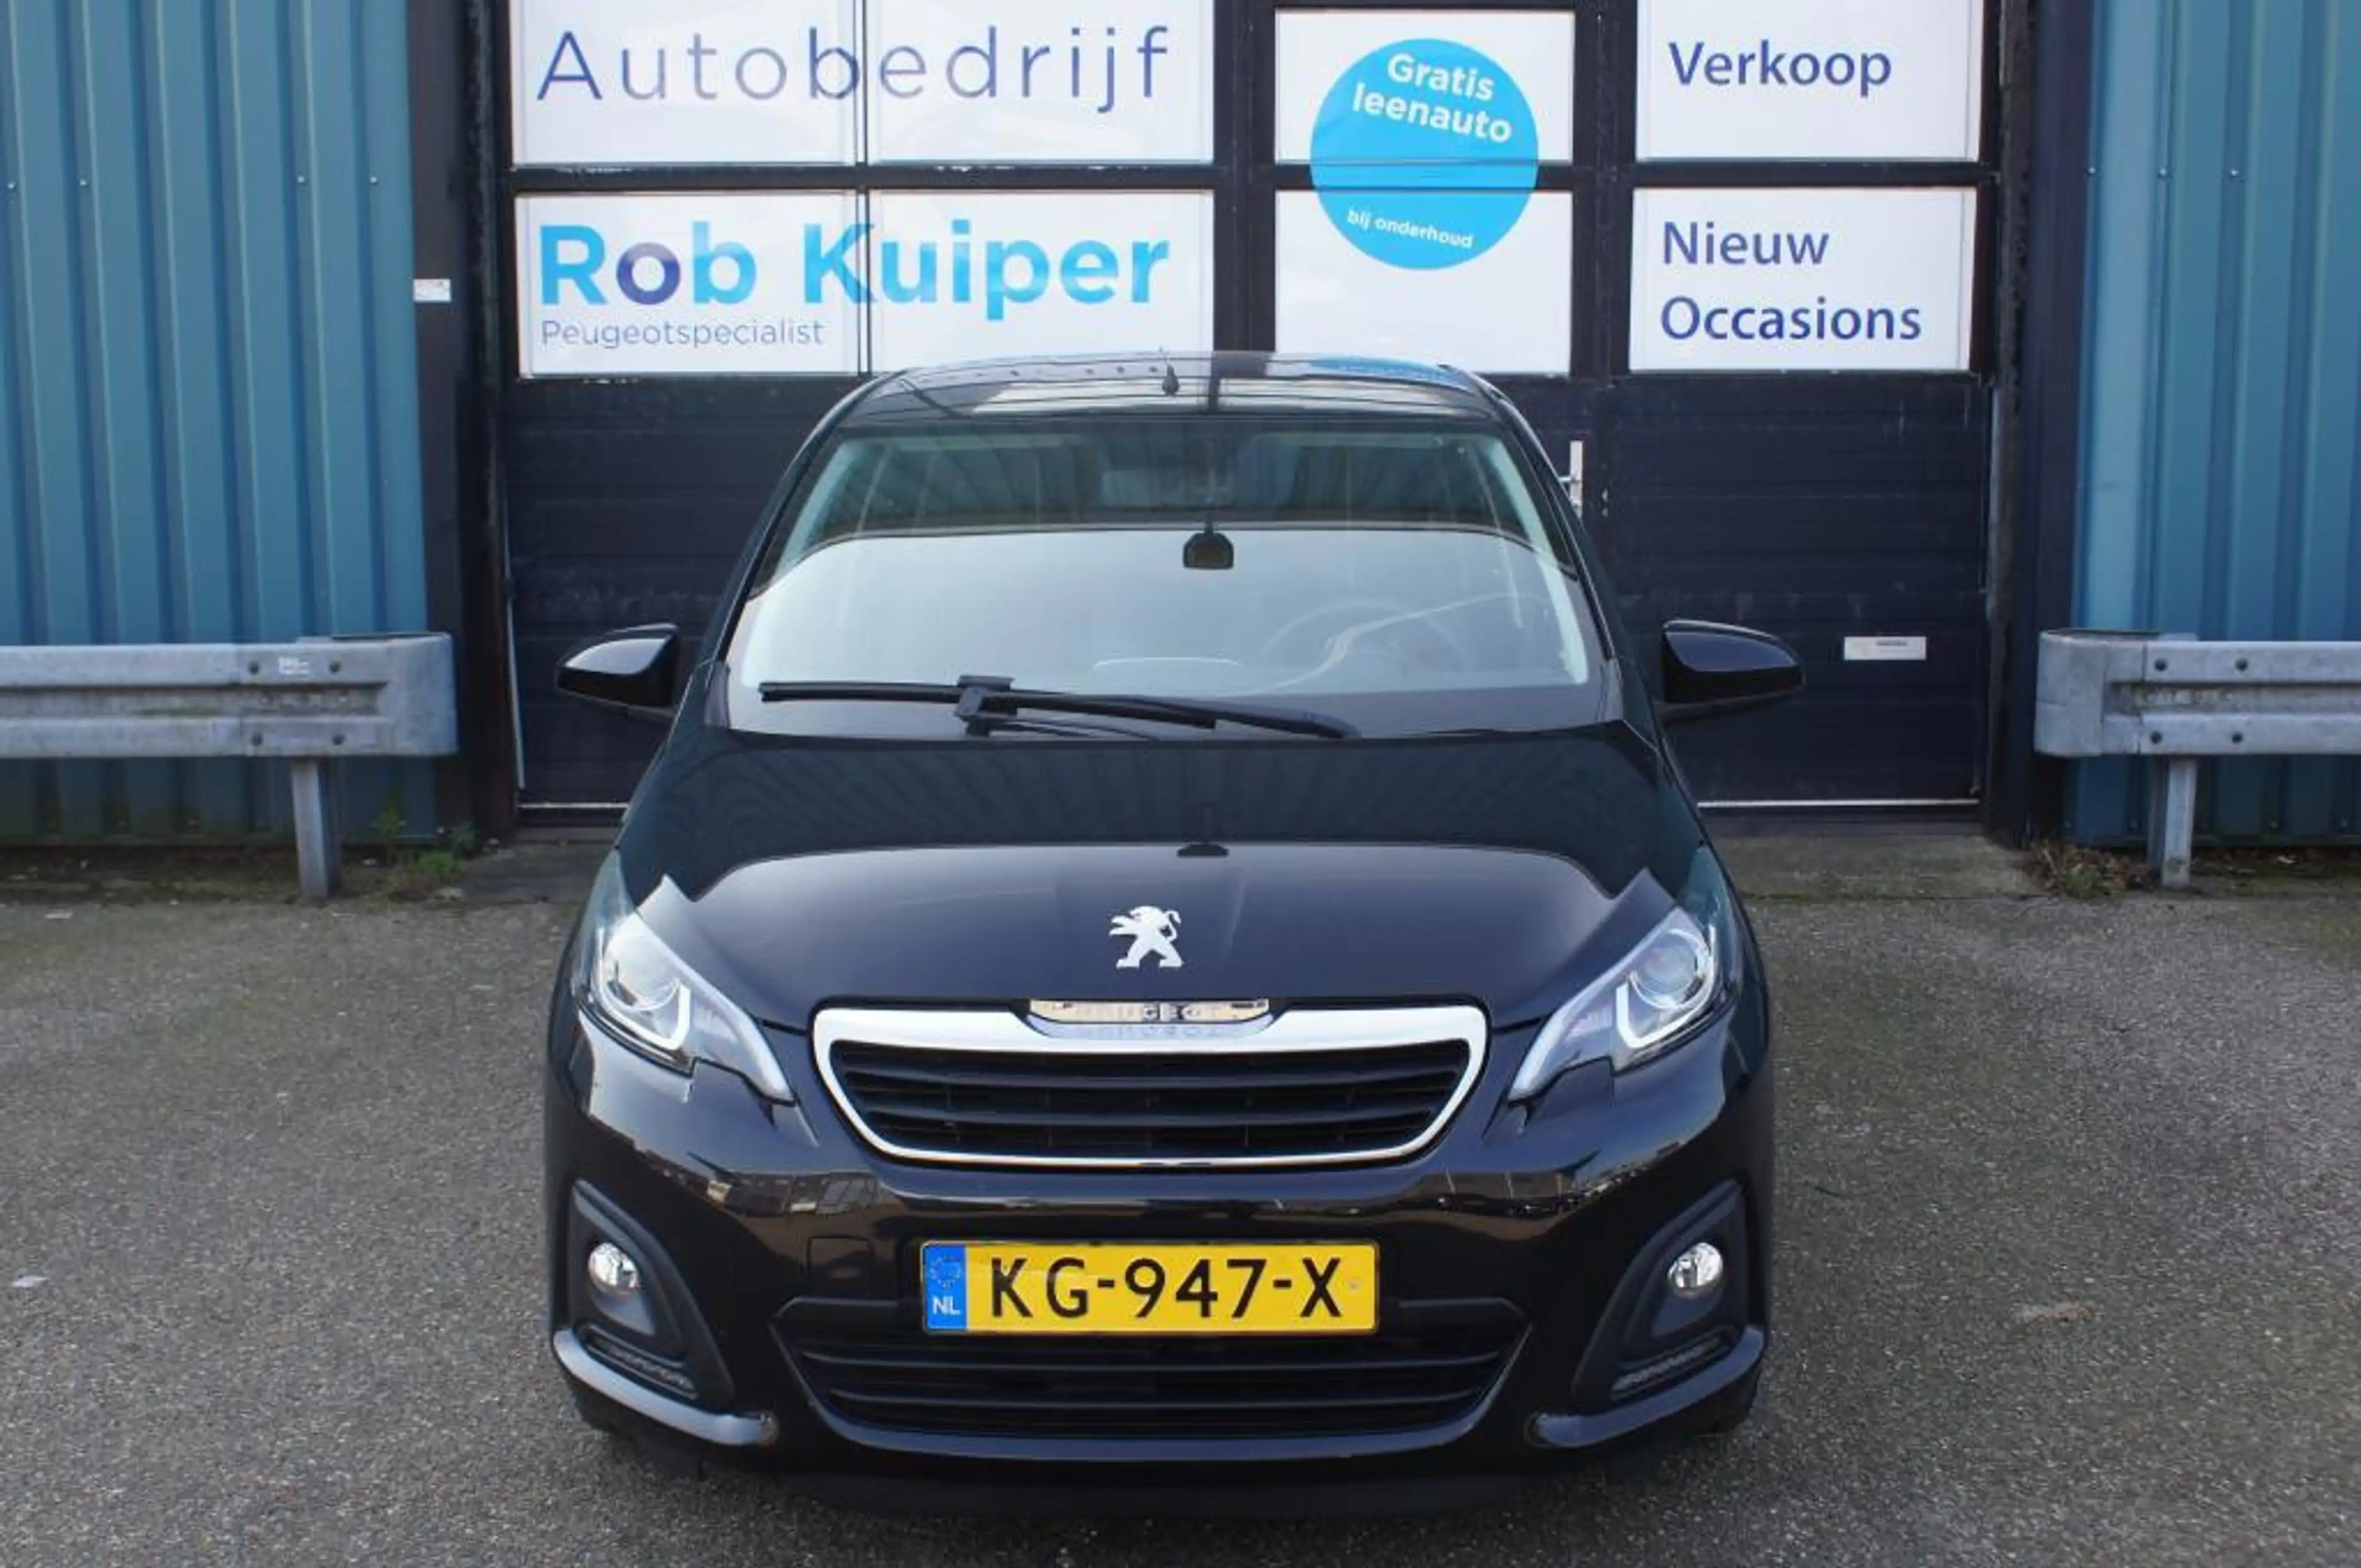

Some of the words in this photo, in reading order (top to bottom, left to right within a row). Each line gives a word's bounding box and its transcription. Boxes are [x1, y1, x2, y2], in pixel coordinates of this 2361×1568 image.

[537, 26, 1168, 114] Autobedrijf
[1387, 53, 1495, 101] Gratis
[1668, 39, 1892, 97] Verkoop
[1353, 82, 1513, 143] leenauto
[1347, 208, 1372, 229] bij
[1374, 215, 1474, 248] onderhoud
[1663, 221, 1830, 264] Nieuw
[540, 221, 756, 306] Rob
[803, 219, 1169, 321] Kuiper
[540, 320, 825, 349] Peugeotspecialist
[1660, 296, 1922, 340] Occasions
[933, 1296, 960, 1315] NL
[991, 1257, 1342, 1318] KG-947-X
